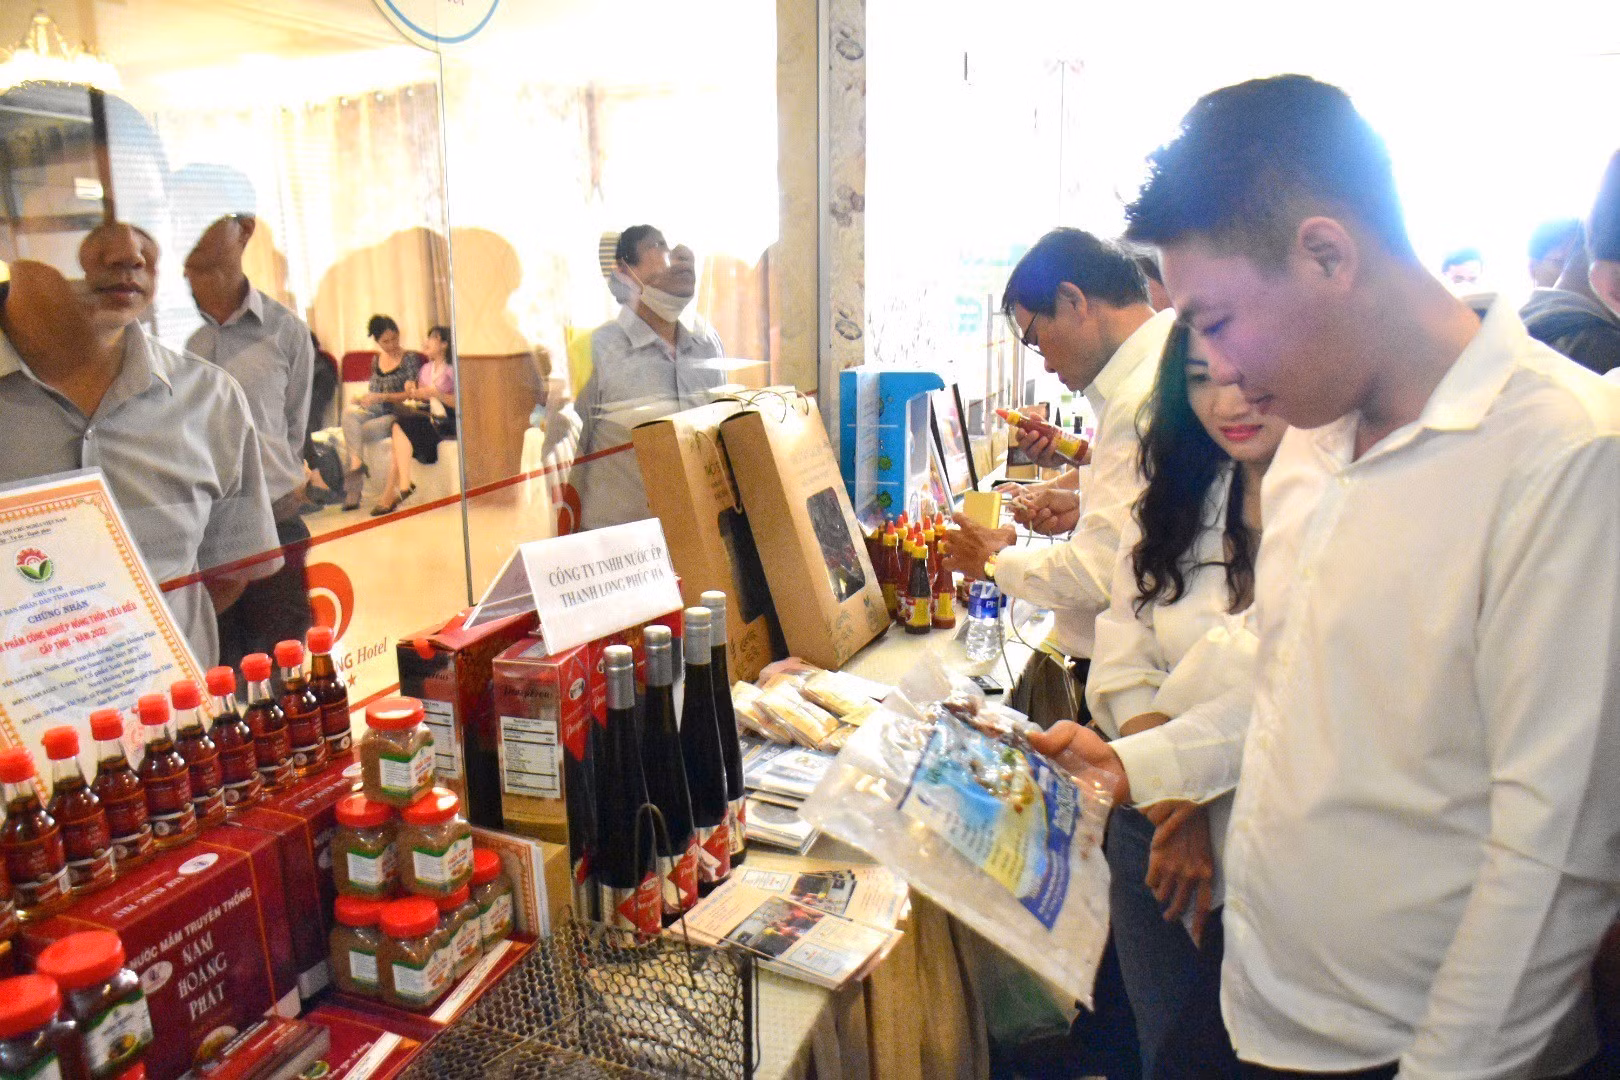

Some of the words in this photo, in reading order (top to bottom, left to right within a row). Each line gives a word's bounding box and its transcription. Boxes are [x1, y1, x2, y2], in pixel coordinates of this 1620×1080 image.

[549, 566, 581, 587] CÔNG
[581, 562, 595, 578] TY
[596, 556, 624, 575] TNHH
[560, 585, 598, 608] THANH
[598, 577, 626, 597] LONG
[357, 636, 387, 664] Hotel
